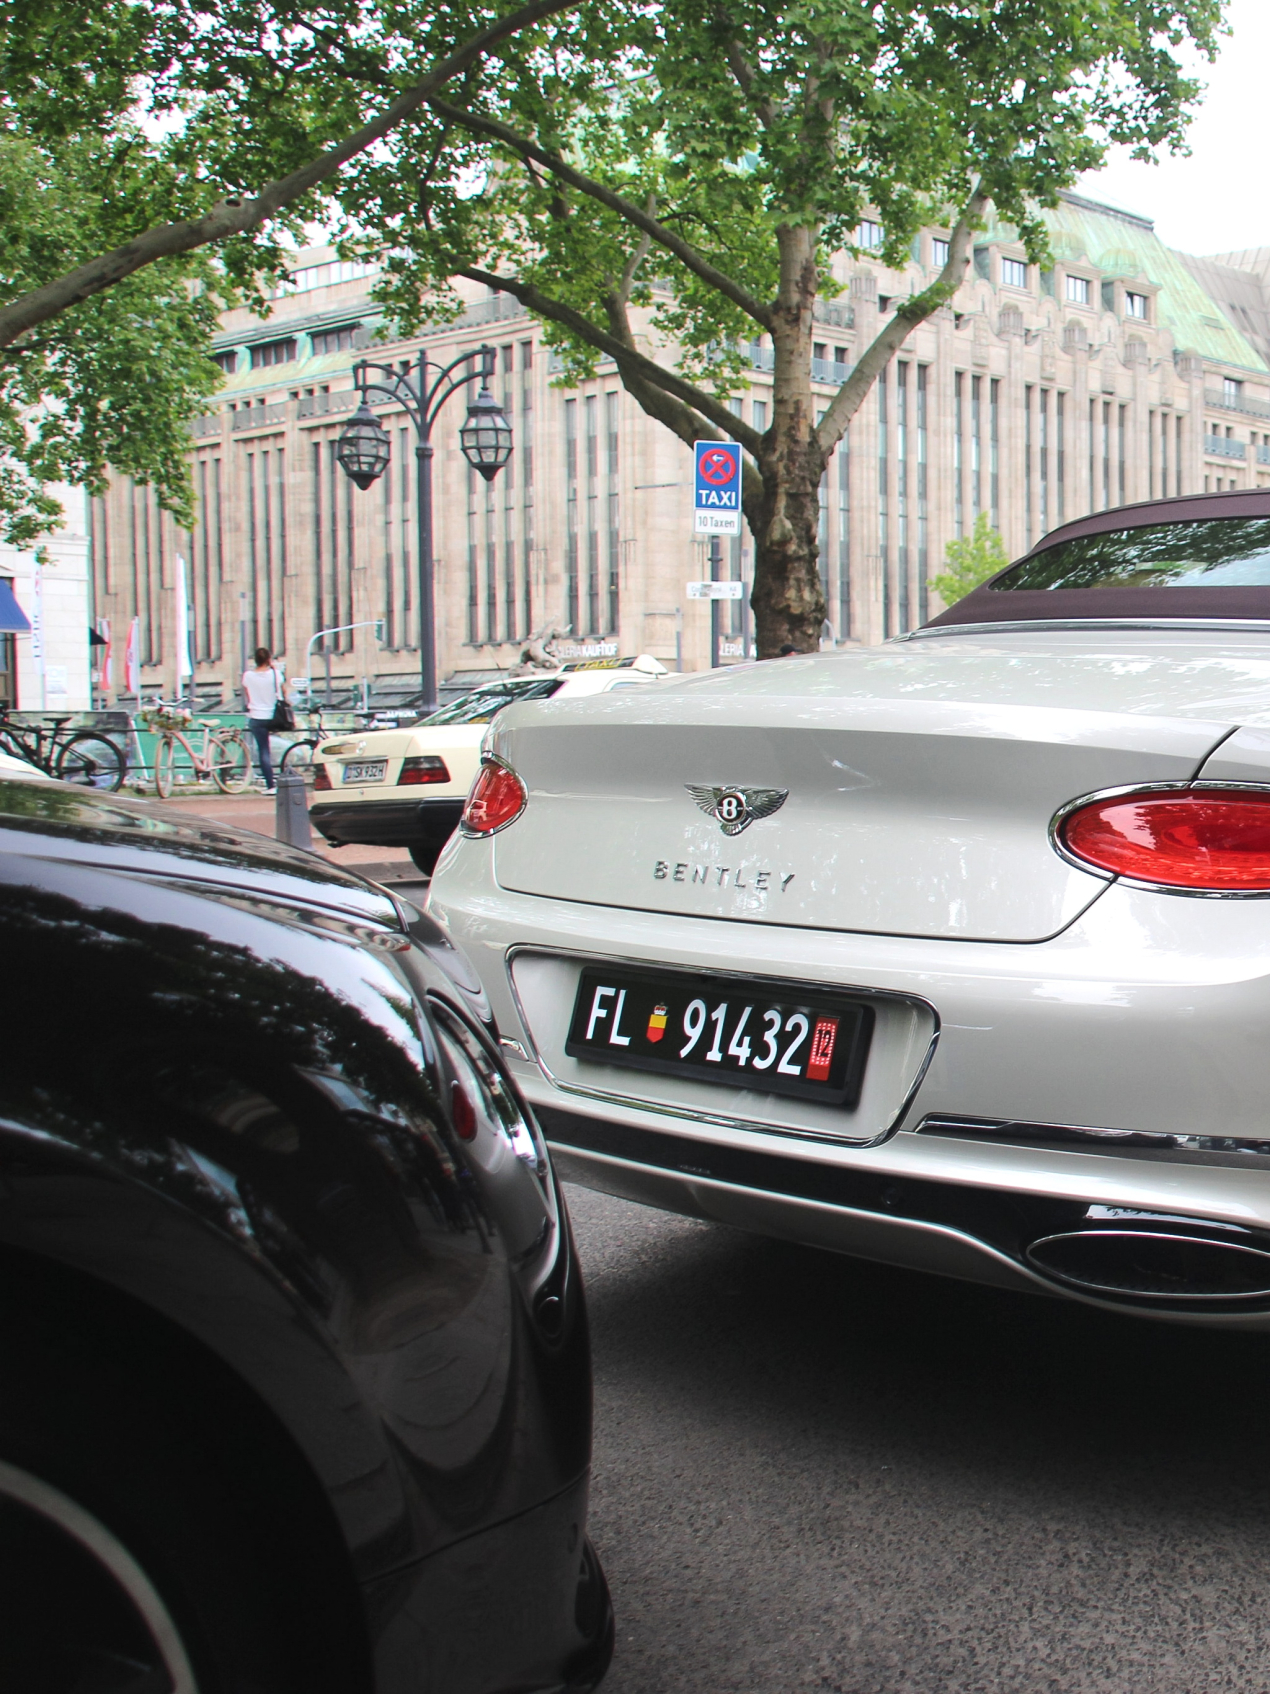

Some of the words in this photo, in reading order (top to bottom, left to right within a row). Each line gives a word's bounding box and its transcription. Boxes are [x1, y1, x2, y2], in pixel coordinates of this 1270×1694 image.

[698, 489, 736, 506] TAXI
[698, 516, 708, 527] 10
[709, 516, 735, 528] Taxen
[653, 860, 795, 892] BENTLEY
[585, 985, 631, 1046] FL
[680, 999, 808, 1076] 91432
